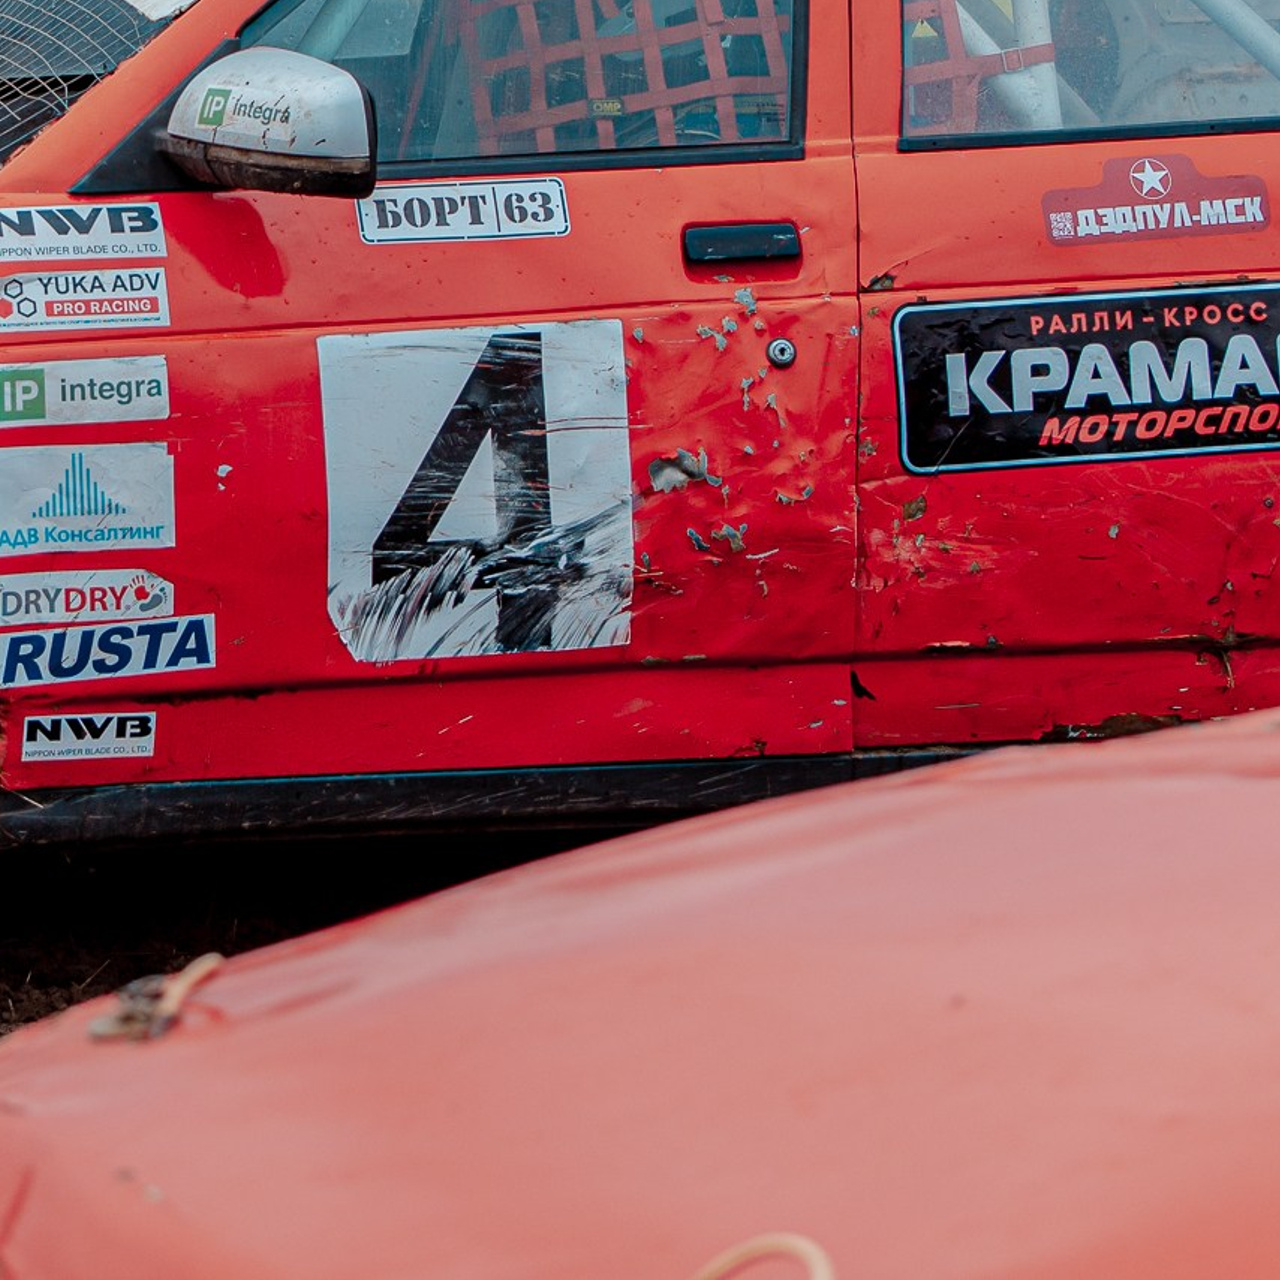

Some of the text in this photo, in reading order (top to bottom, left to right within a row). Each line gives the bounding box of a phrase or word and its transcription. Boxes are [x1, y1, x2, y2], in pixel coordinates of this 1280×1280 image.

[203, 95, 291, 125] IP integra
[373, 191, 555, 229] БОРТ 63
[1076, 196, 1265, 237] ДЭДПУЛ-МСК
[34, 246, 69, 256] WIPER
[72, 244, 108, 255] BLADE
[111, 244, 134, 255] CO.,
[137, 243, 161, 253] LTD.
[37, 272, 161, 296] YUKA ADV
[53, 299, 151, 315] PRO RACING
[945, 333, 1280, 417] КРАМА
[3, 378, 162, 412] IP integra
[1038, 403, 1280, 446] МОТОРСПО
[371, 331, 585, 650] 4
[44, 524, 165, 543] Консалтинг
[2, 618, 211, 684] RUSTA
[26, 715, 153, 742] NWB
[24, 749, 55, 758] NIPPON
[57, 748, 83, 756] WIPER
[85, 747, 110, 756] BLADE
